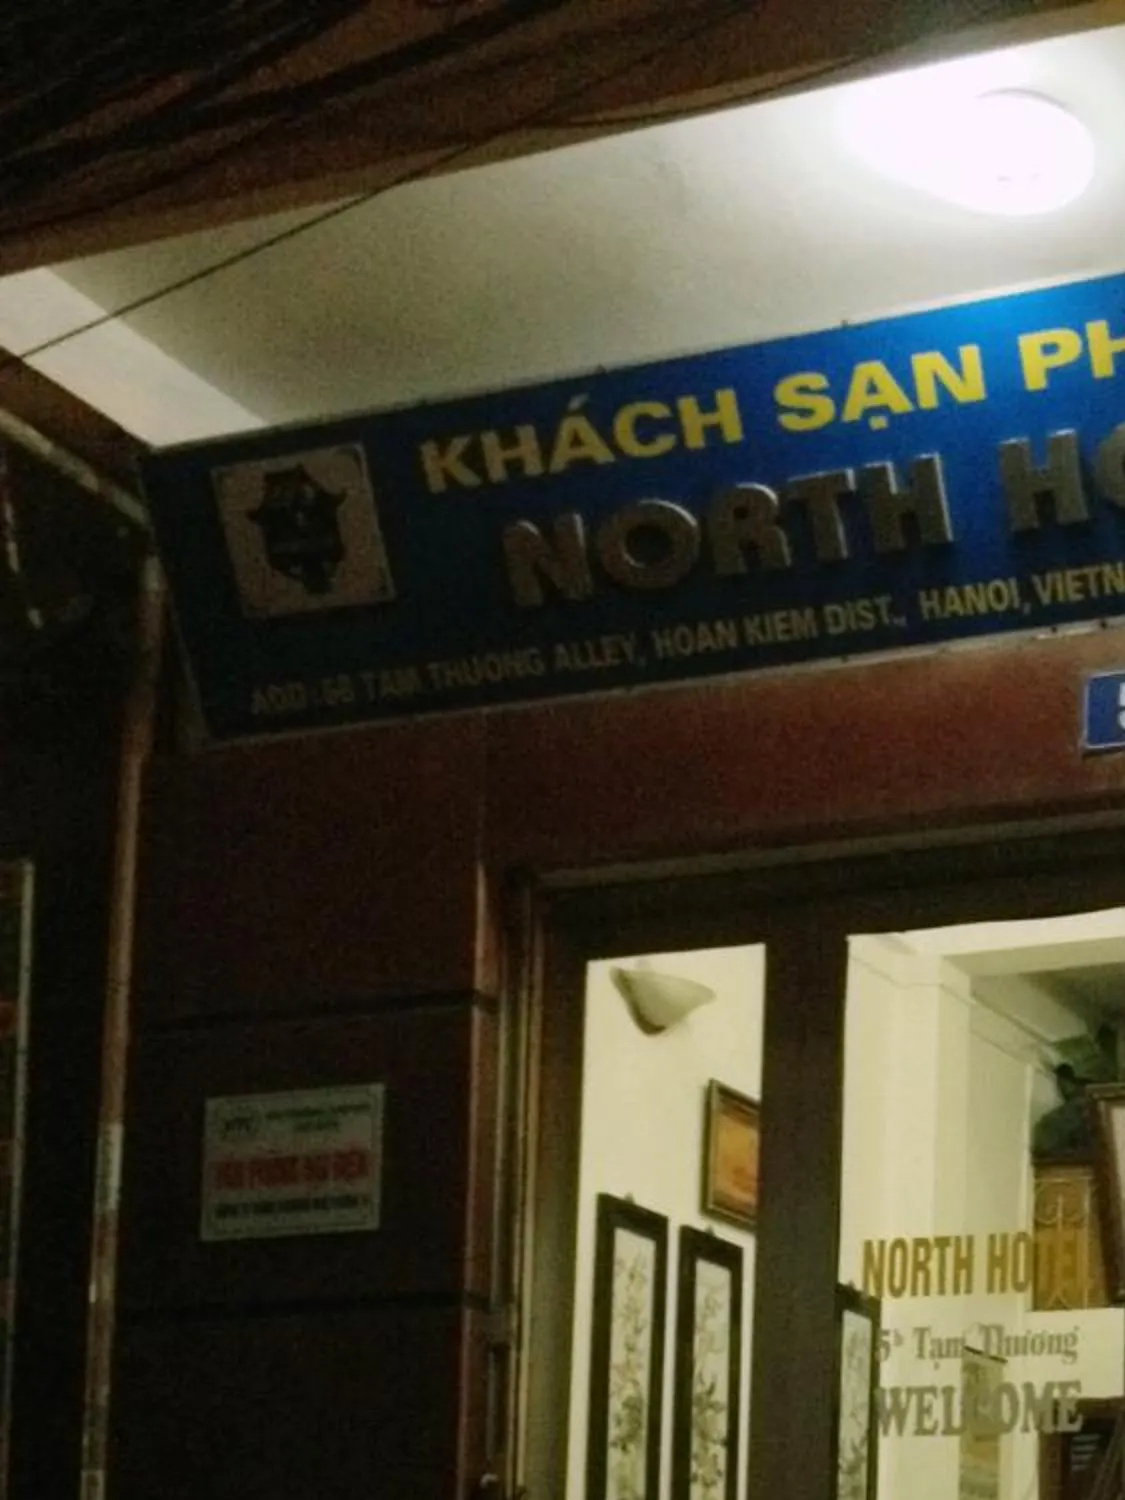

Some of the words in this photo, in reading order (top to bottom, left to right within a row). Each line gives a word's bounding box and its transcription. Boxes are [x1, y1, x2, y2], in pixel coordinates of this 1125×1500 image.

[418, 387, 744, 494] KHÁCH
[772, 342, 988, 433] SẠN
[501, 450, 954, 608] NORTH
[426, 646, 546, 691] THUONG
[655, 616, 737, 661] HOAN
[743, 605, 819, 647] KIEM
[863, 1235, 974, 1298] NORTH
[872, 1379, 1084, 1438] WELCOME
